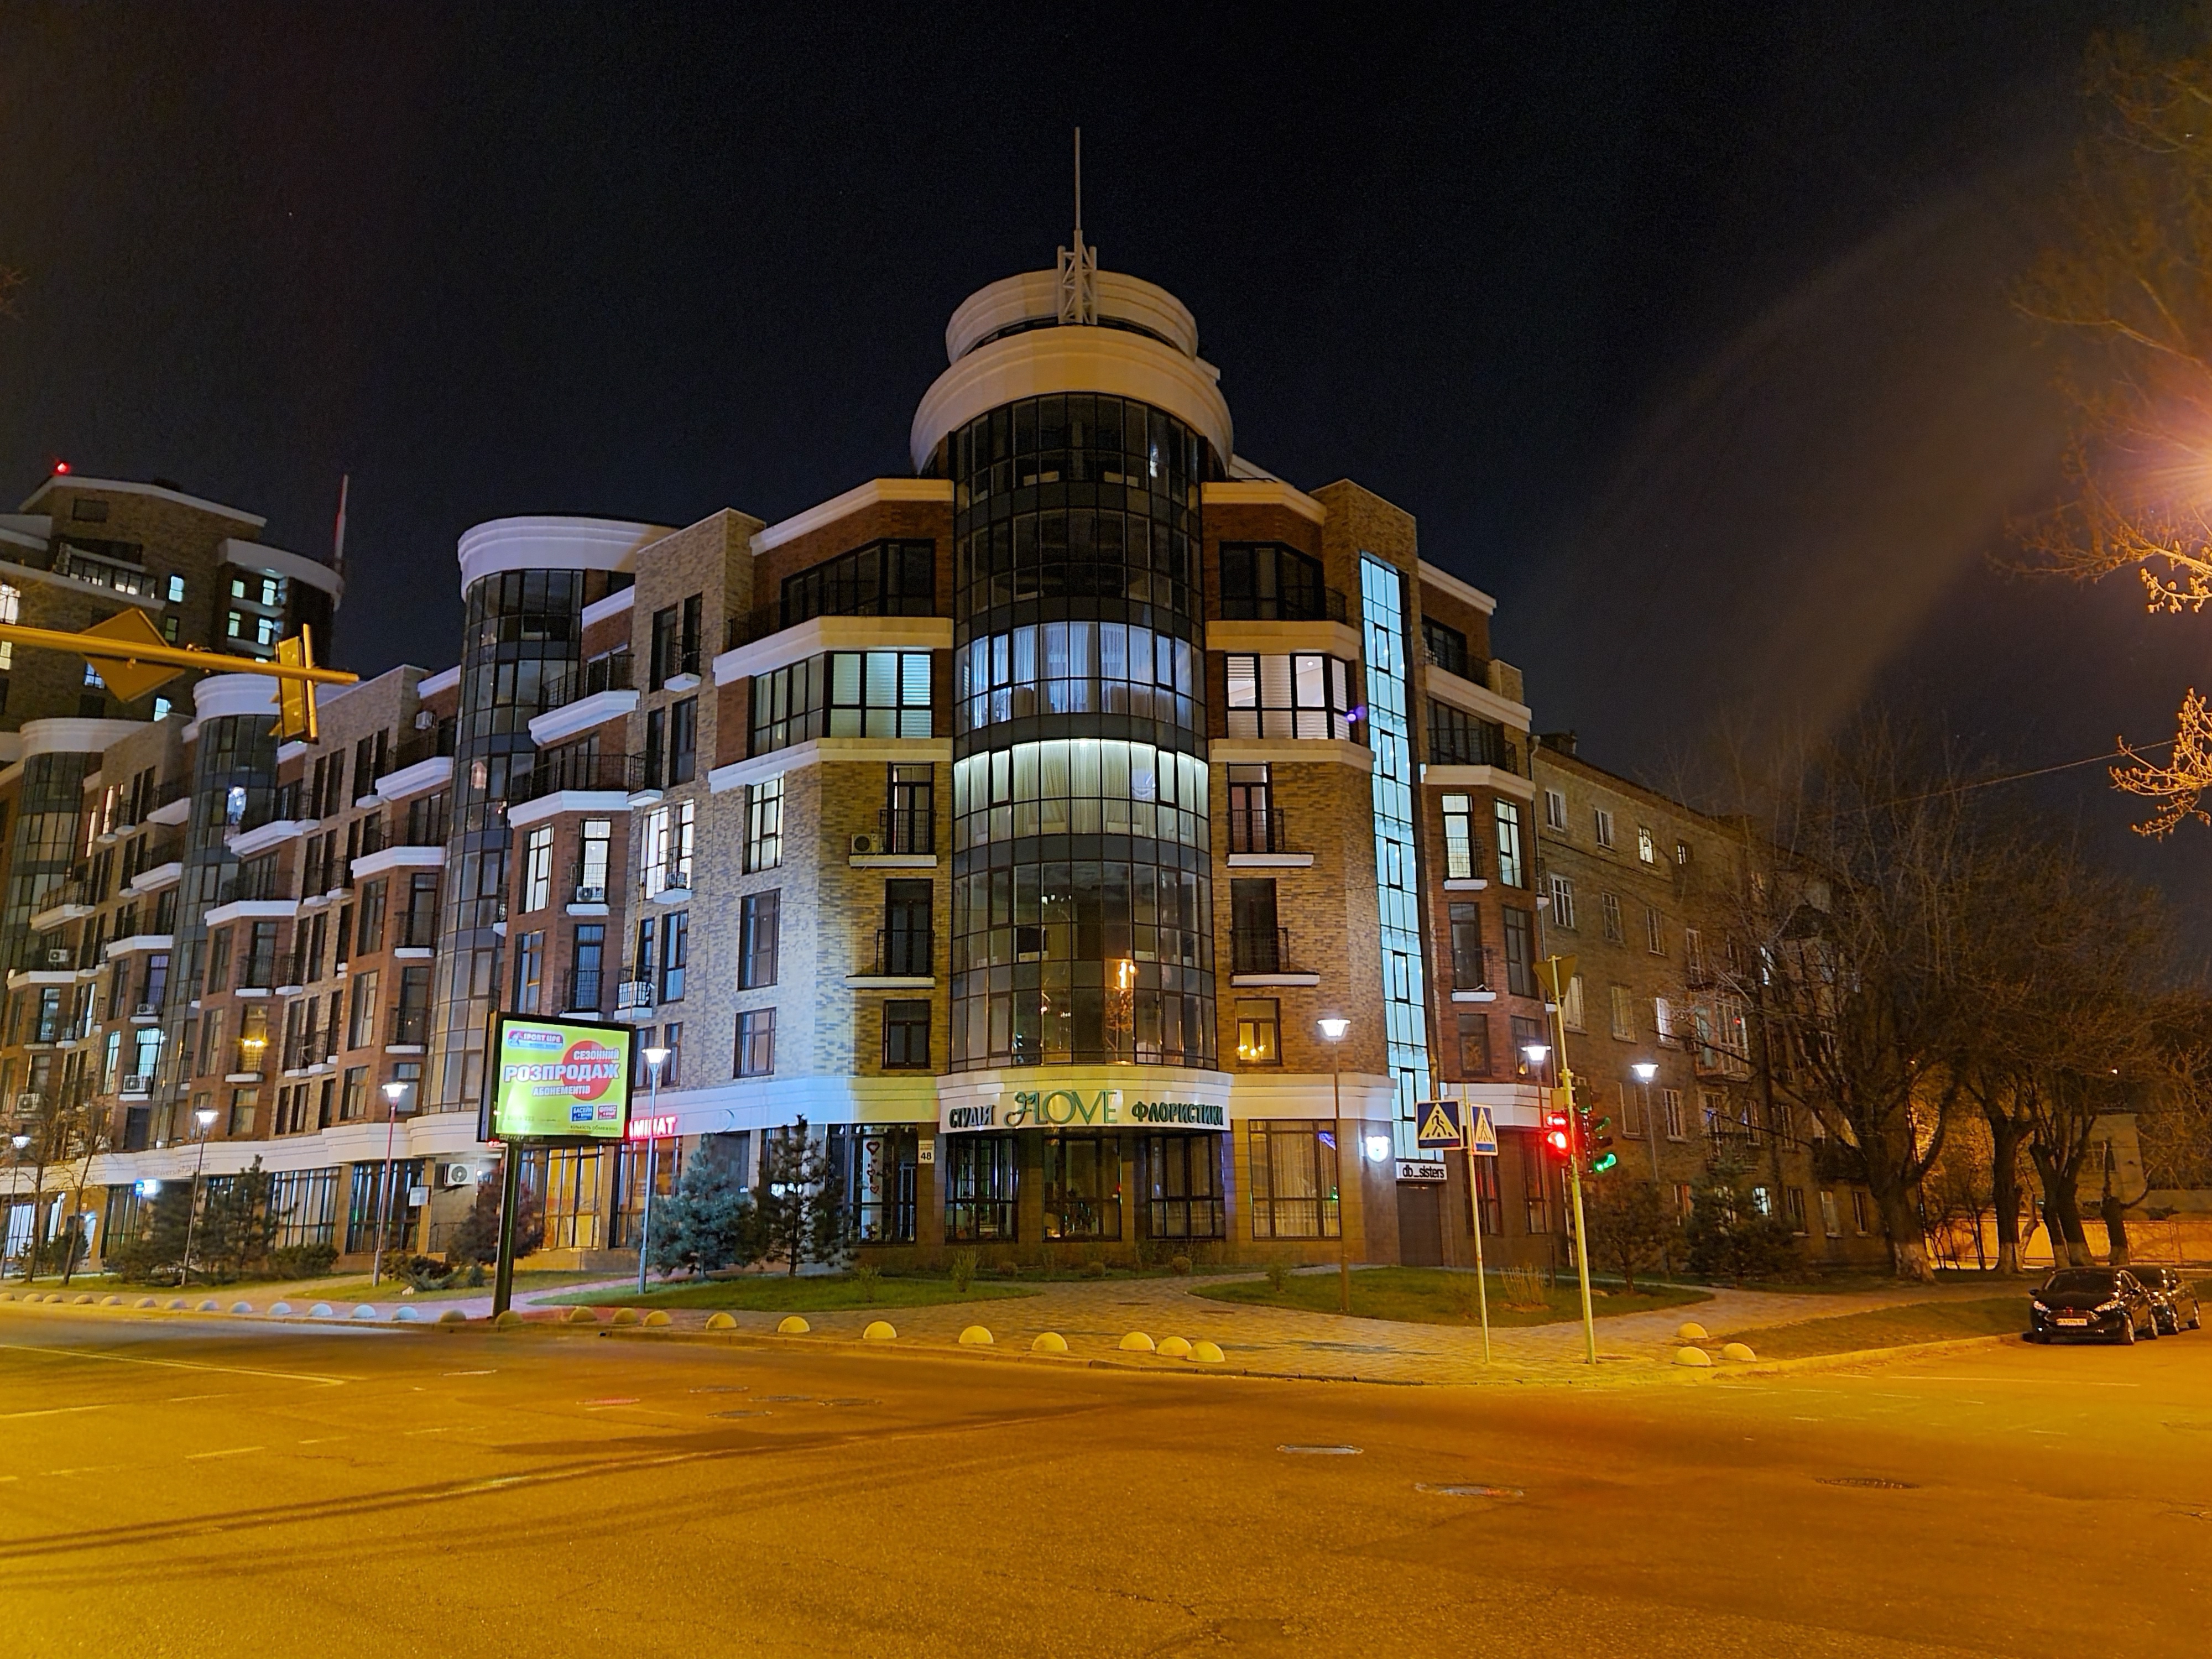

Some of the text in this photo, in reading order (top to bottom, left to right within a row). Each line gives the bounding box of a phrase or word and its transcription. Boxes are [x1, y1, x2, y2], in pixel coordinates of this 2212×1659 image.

[573, 1048, 620, 1061] СЕЗОННИЙ
[504, 1063, 620, 1083] РОЗПРОДАЖ
[533, 1085, 591, 1097] АБОНЕМЕНТІВ
[949, 1104, 994, 1128] СТУДІЯ
[1131, 1101, 1224, 1125] ФЛОРИСТИКИ
[920, 1152, 932, 1160] 48
[1402, 1164, 1444, 1178] db_sisters
